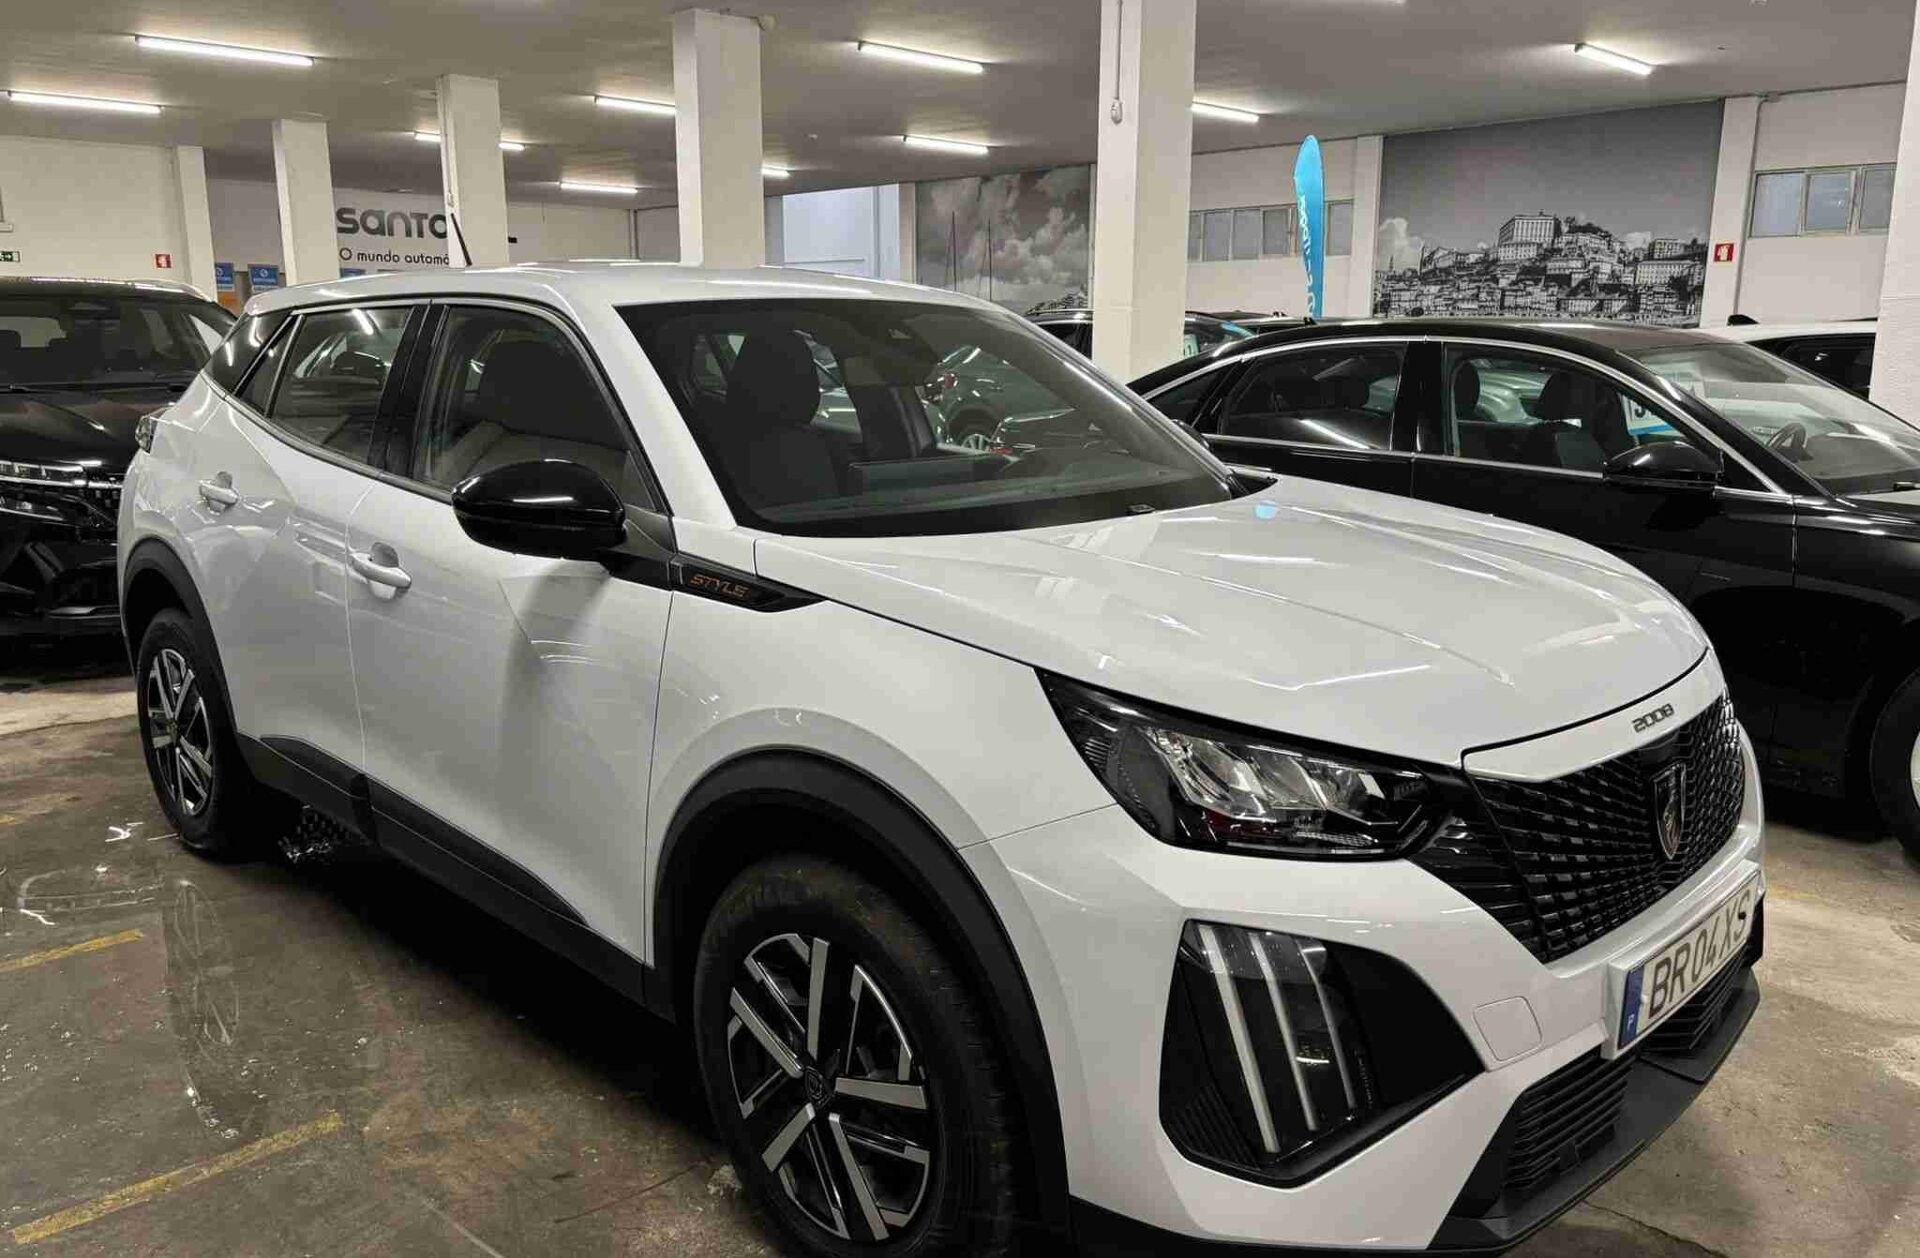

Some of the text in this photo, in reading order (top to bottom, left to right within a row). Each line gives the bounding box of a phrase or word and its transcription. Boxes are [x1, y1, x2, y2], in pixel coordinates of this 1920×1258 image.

[339, 248, 352, 260] O
[357, 250, 400, 263] mundo
[690, 574, 749, 597] STYLE
[1631, 703, 1674, 733] 2008
